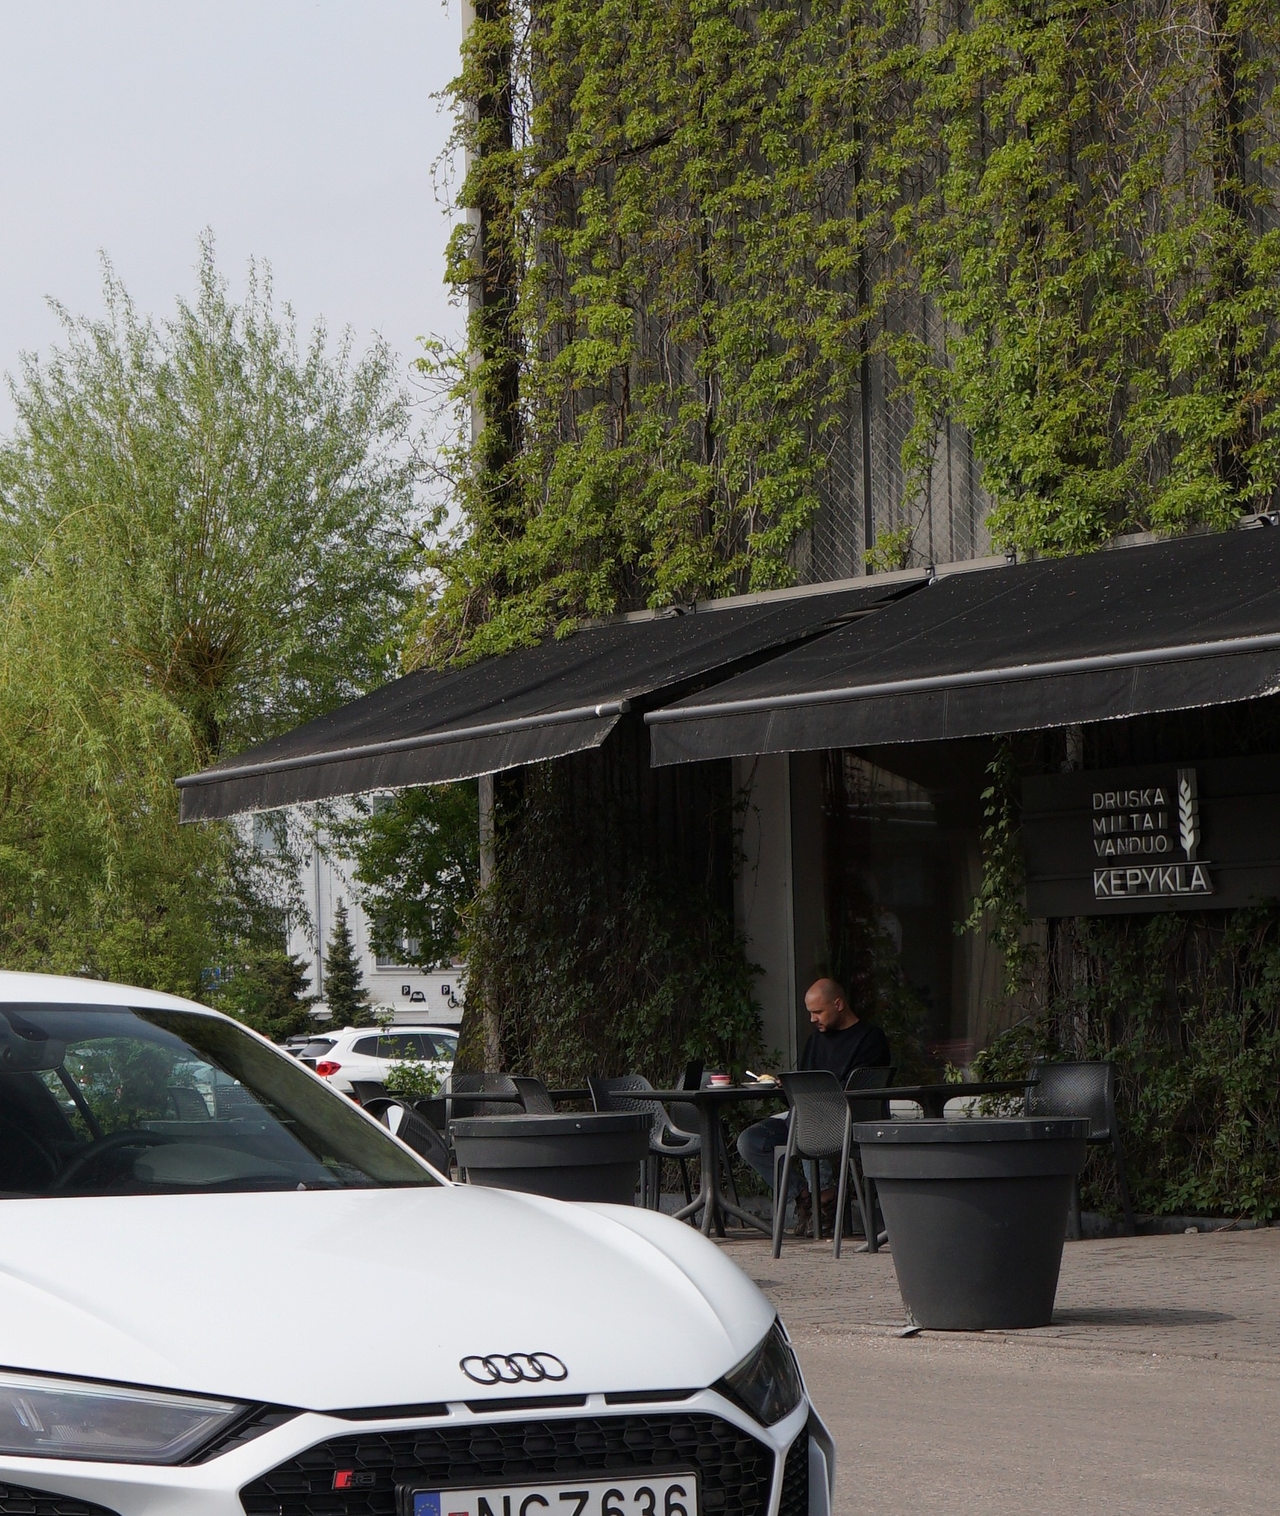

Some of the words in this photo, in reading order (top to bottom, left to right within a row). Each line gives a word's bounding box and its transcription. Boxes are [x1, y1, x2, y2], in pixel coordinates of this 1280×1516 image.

[1092, 787, 1165, 810] DRUSKA
[1092, 811, 1164, 835] MILTAI
[1093, 835, 1168, 857] VANDUO
[1093, 865, 1208, 896] KEPYKLA
